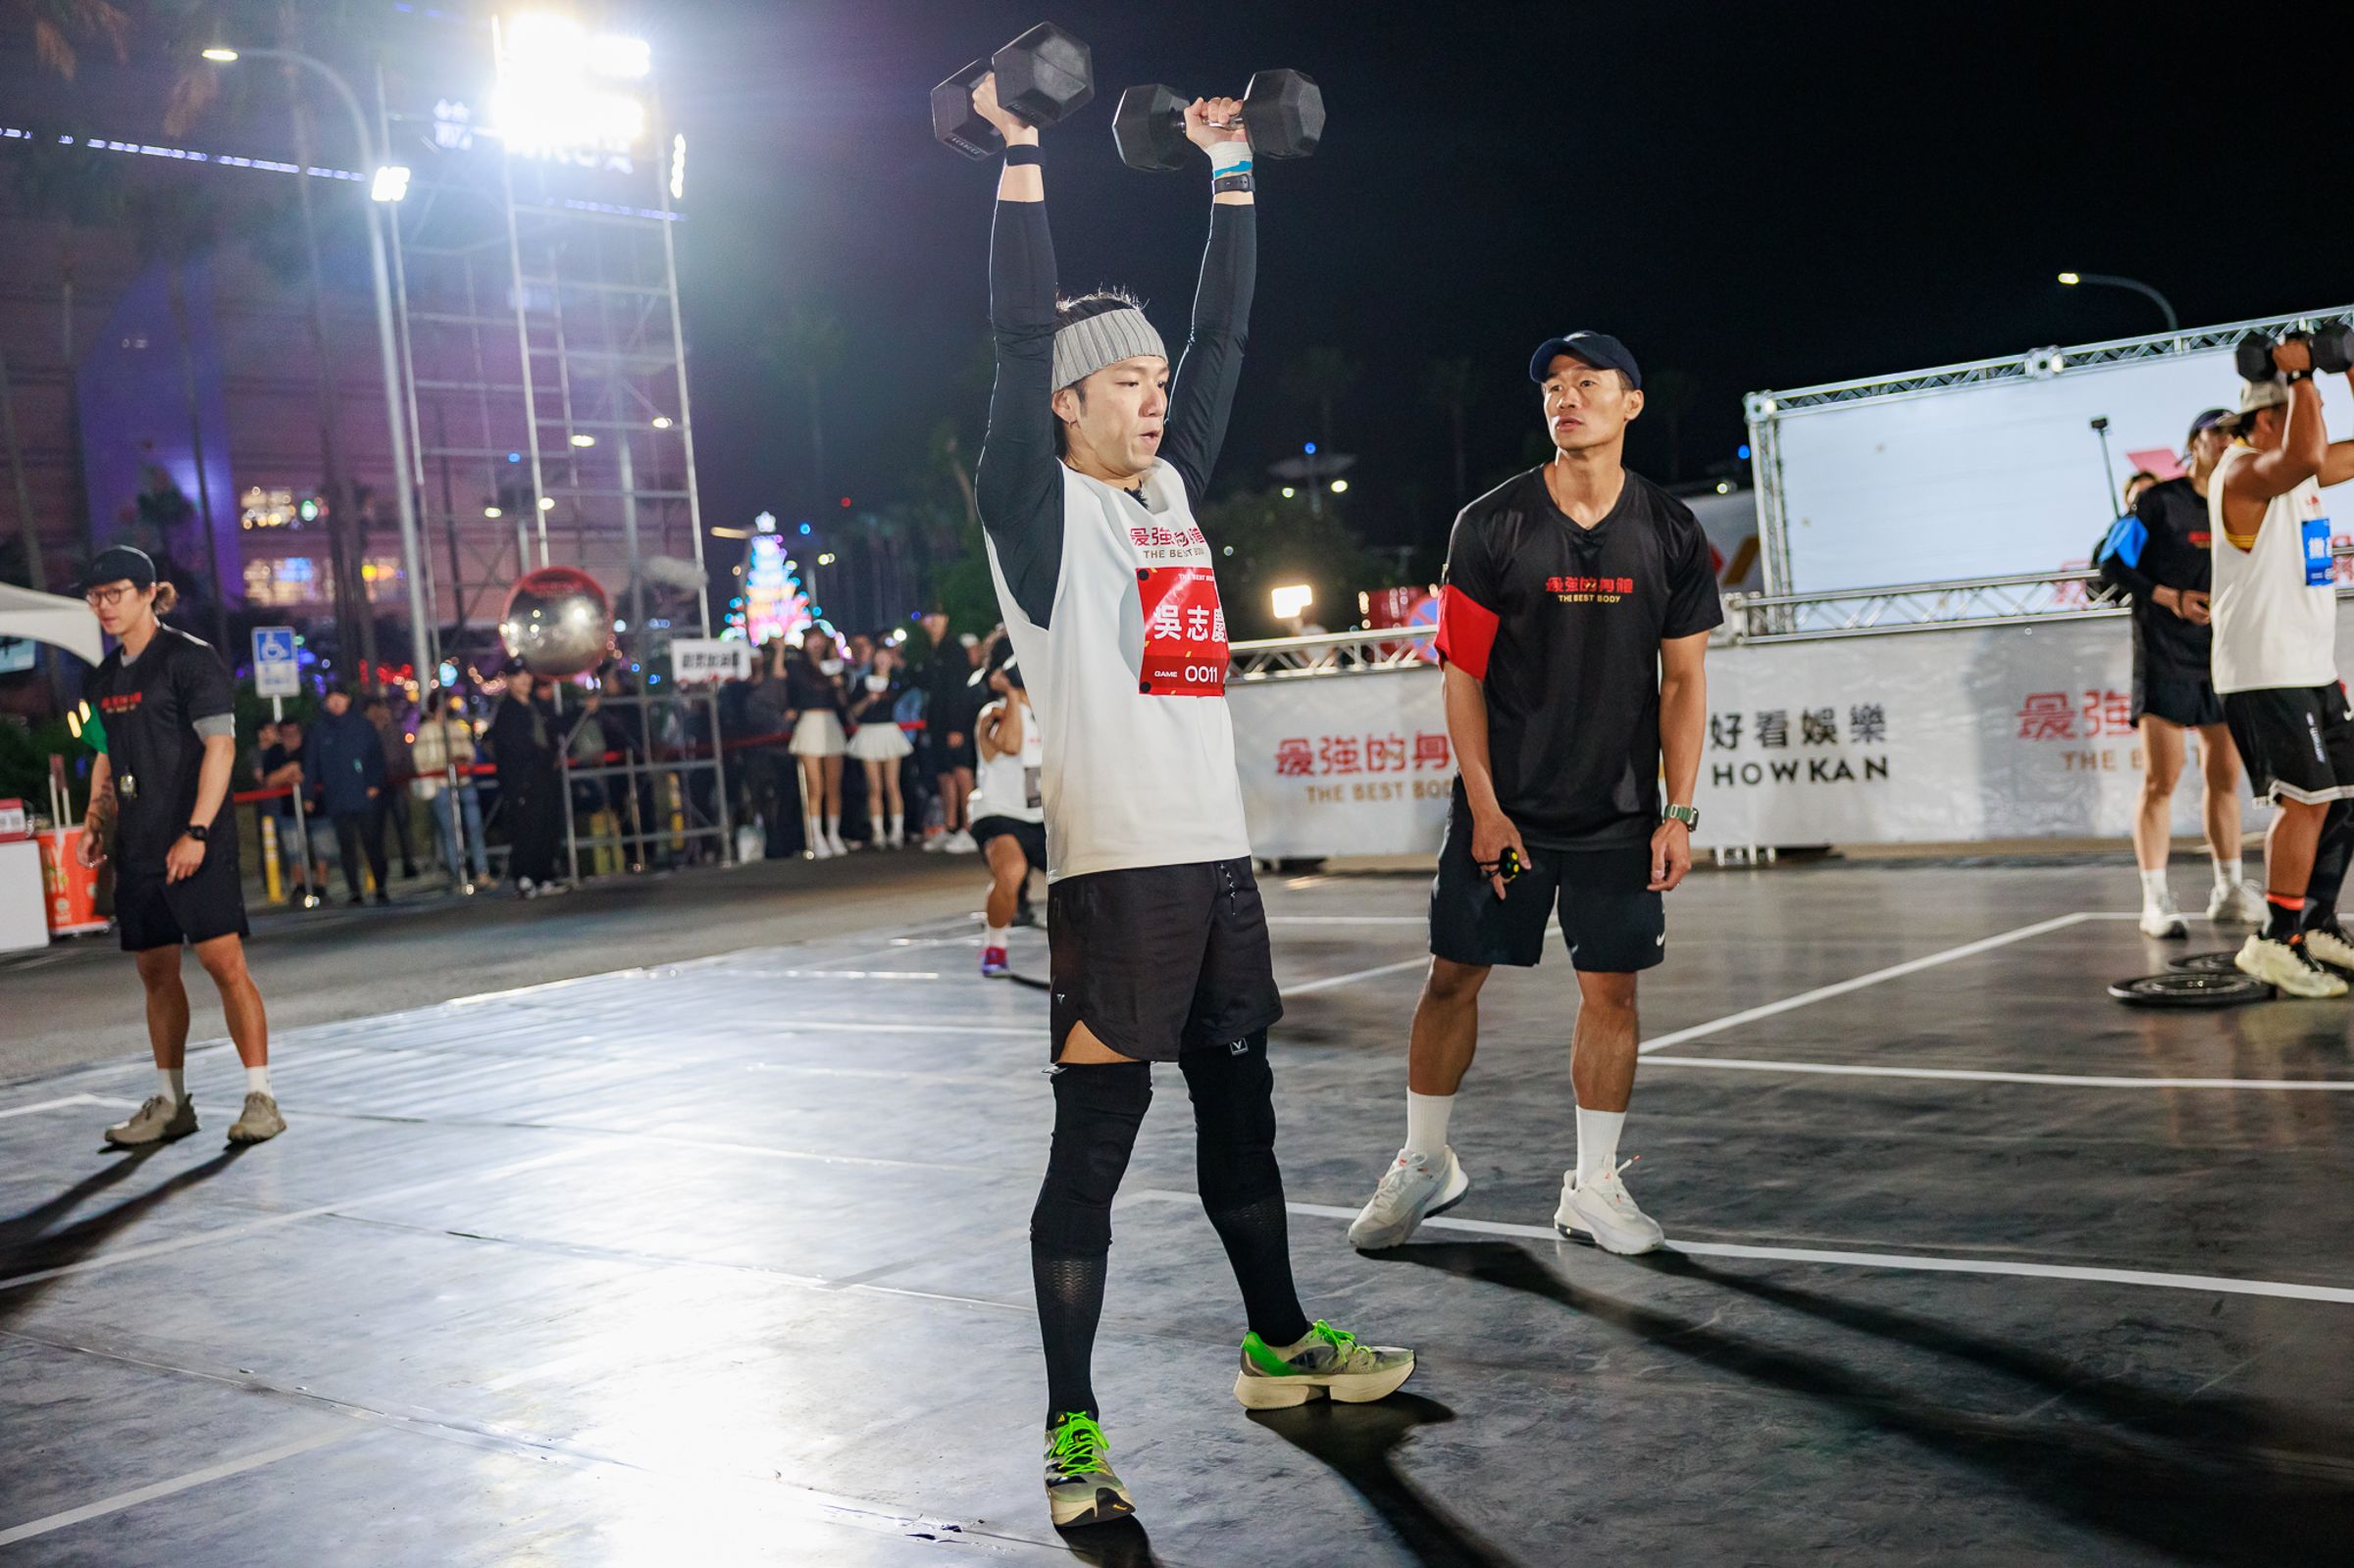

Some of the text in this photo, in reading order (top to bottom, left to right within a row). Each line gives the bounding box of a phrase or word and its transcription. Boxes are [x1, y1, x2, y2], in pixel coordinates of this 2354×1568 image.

[1144, 550, 1165, 559] THE
[1170, 549, 1192, 558] BEST
[1546, 577, 1633, 593] 最強的身體
[1558, 594, 1572, 603] THE
[1185, 665, 1217, 683] 0011
[1711, 703, 1886, 750] 好看娛樂
[1275, 731, 1451, 777] 最強的身
[2061, 749, 2117, 771] THE
[1712, 755, 1888, 787] HOWKAN
[1305, 779, 1454, 803] THE BEST BO
